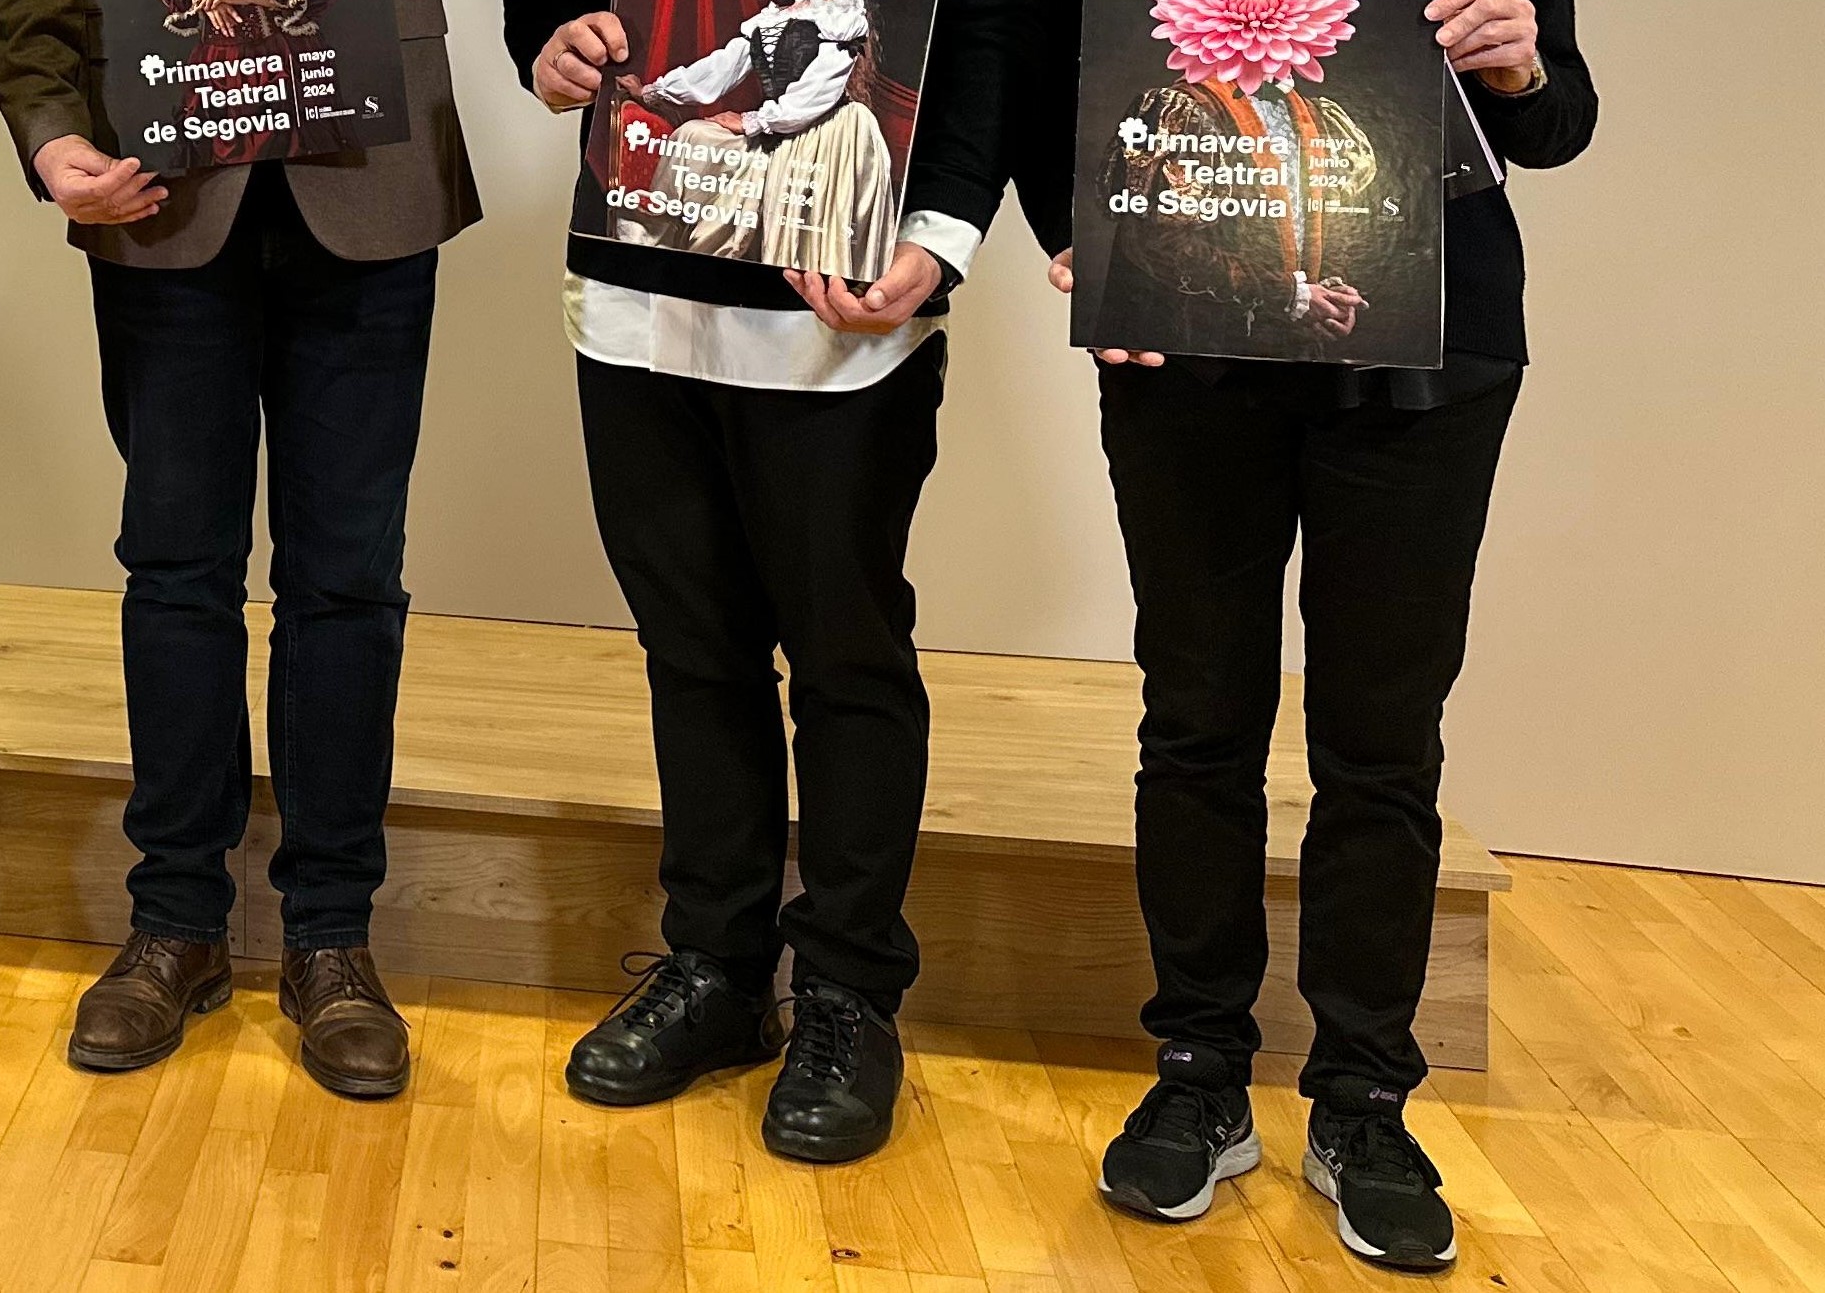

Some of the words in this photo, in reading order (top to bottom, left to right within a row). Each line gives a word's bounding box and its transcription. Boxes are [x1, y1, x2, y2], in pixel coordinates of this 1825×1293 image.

[140, 54, 283, 85] Primavera
[298, 49, 336, 62] mayo
[300, 66, 334, 82] junio
[195, 78, 287, 109] Teatral
[302, 83, 335, 97] 2024
[143, 121, 176, 144] de
[183, 109, 290, 141] Segovia
[1118, 117, 1289, 154] Primavera
[625, 120, 769, 170] Primavera
[1309, 138, 1355, 152] mayo
[1178, 159, 1288, 186] Teatral
[1309, 155, 1350, 169] junio
[671, 165, 766, 200] Teatral
[1308, 174, 1348, 188] 2024
[606, 186, 640, 209] de
[647, 191, 758, 229] Segovia
[1108, 189, 1148, 214] de
[1157, 190, 1286, 222] Segovia
